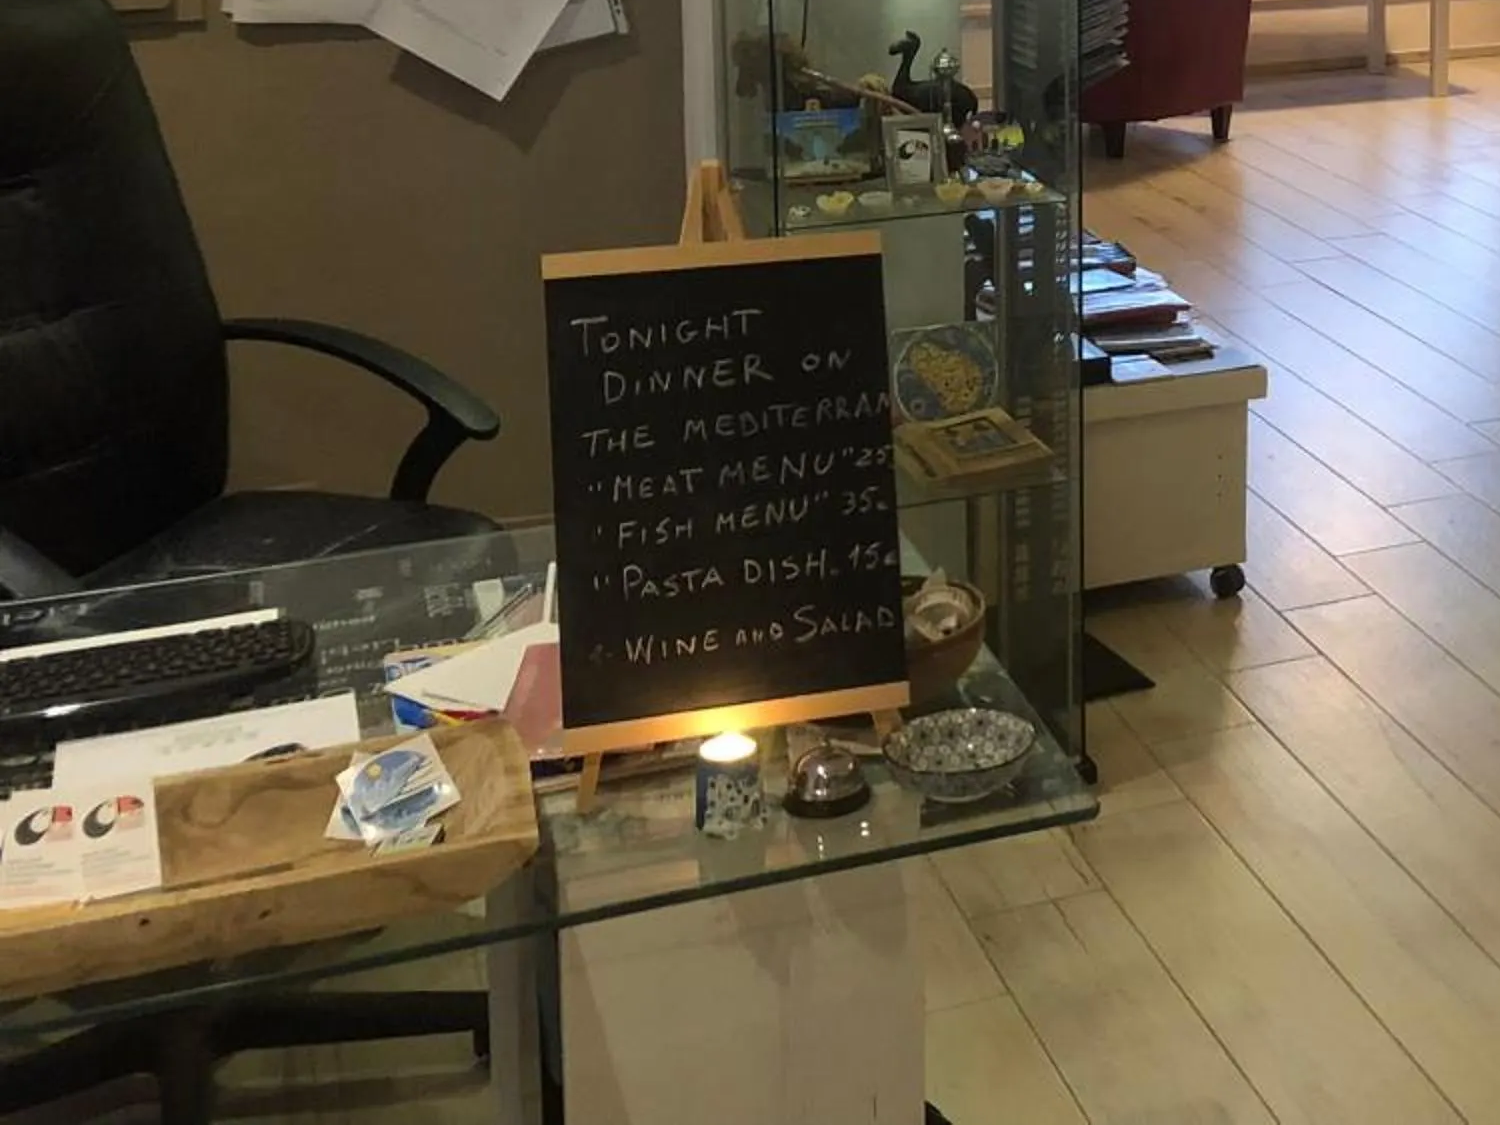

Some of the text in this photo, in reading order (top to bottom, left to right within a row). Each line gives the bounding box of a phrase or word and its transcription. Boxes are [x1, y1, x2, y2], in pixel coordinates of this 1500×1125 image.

[569, 309, 764, 357] TONIGHT
[603, 348, 853, 405] DINNER ON
[580, 425, 656, 459] THE
[625, 629, 720, 665] WINE
[793, 604, 896, 643] SALAD
